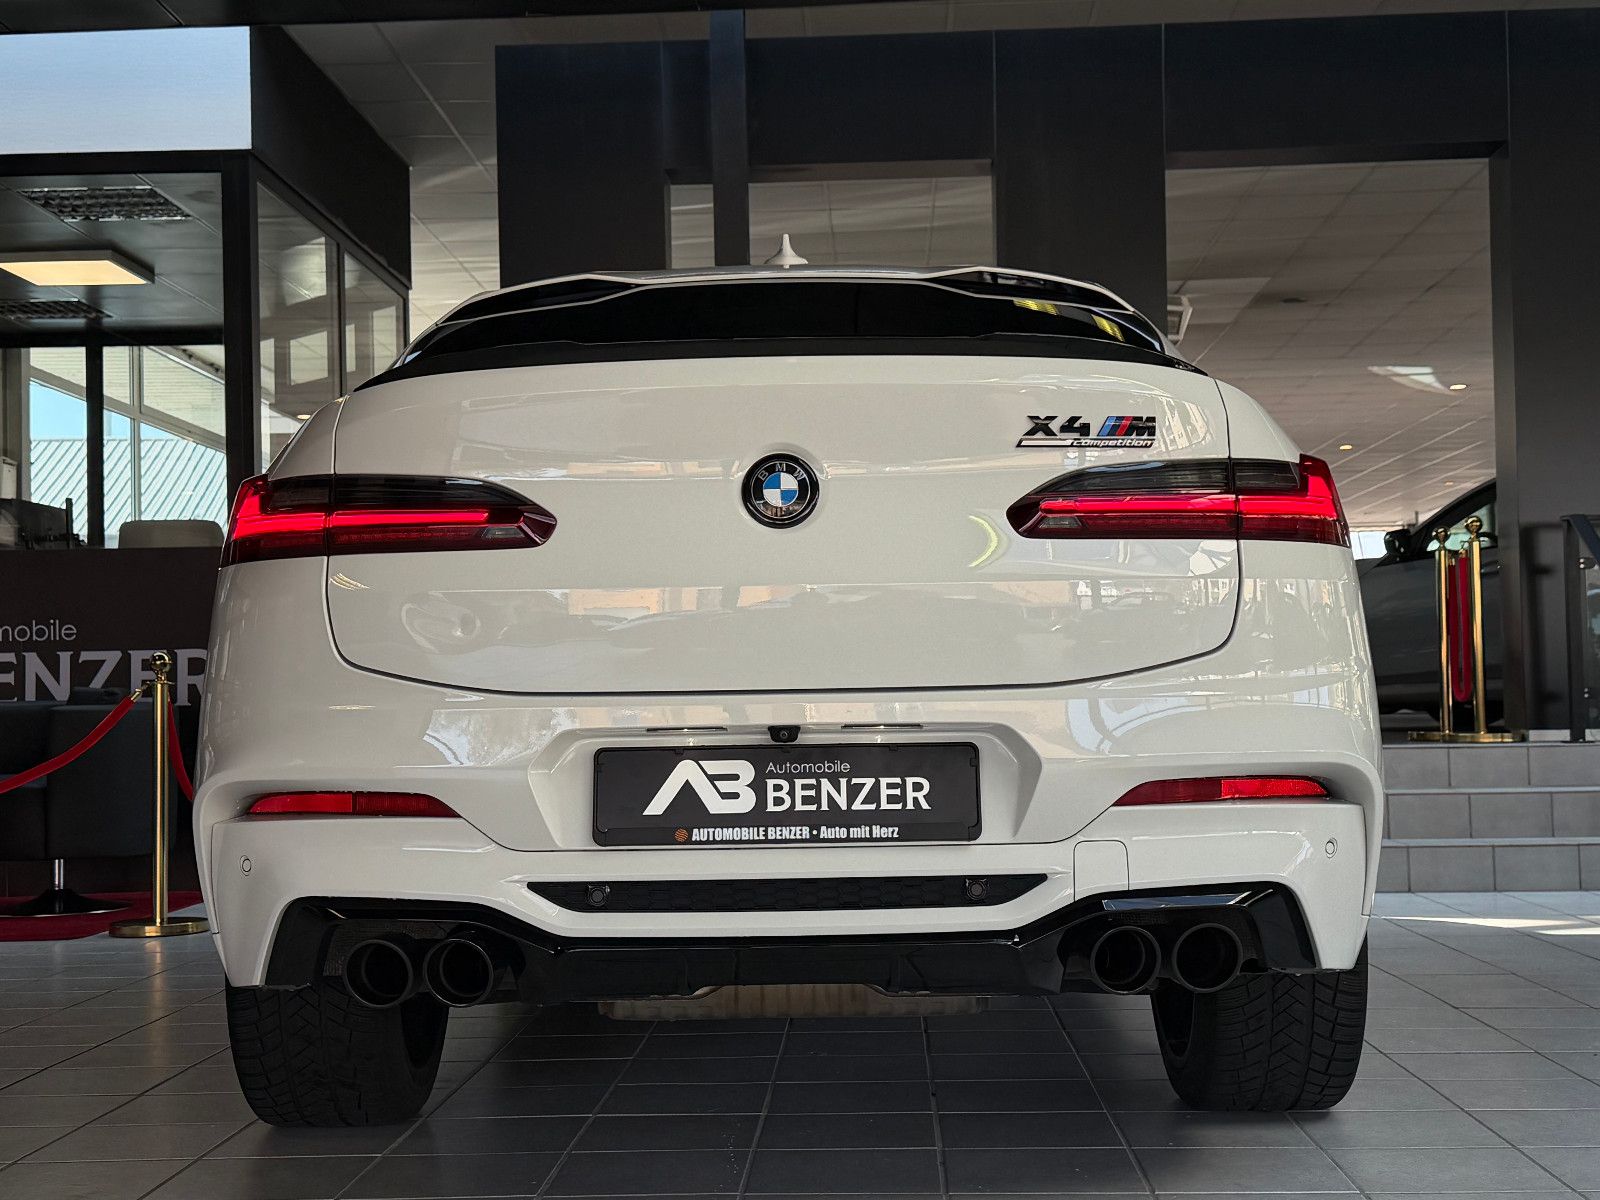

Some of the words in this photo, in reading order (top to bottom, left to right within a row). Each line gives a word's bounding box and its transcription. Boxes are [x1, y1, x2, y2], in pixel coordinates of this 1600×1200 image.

[1022, 415, 1090, 437] X4
[1073, 438, 1152, 448] competition
[758, 462, 806, 481] BMW
[765, 761, 851, 774] Automobile
[642, 759, 757, 816] AB
[765, 777, 932, 812] BENZER
[691, 827, 766, 841] AUTOMOBILE
[767, 826, 810, 840] BENZER
[820, 826, 847, 839] Auto
[849, 825, 870, 838] mit
[872, 825, 899, 838] Herz
